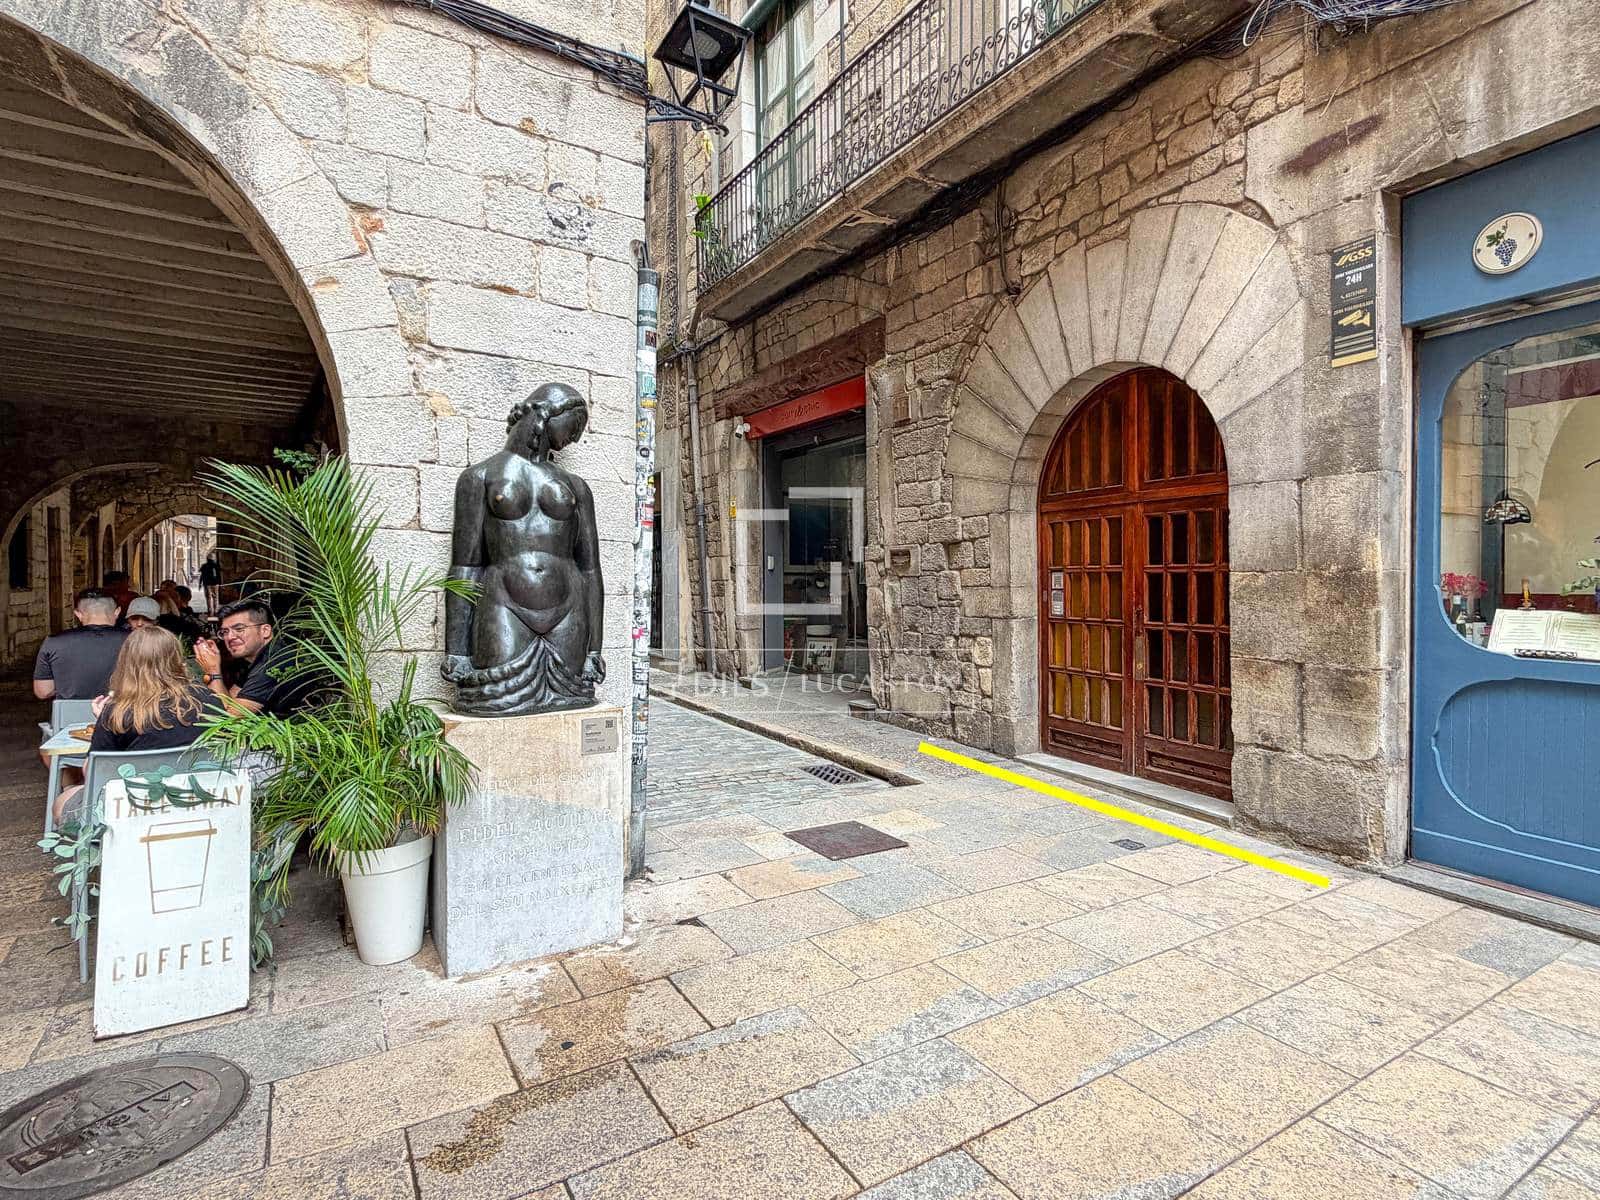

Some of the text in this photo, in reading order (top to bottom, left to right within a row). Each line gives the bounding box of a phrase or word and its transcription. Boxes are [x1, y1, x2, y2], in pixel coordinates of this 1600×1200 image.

[1350, 246, 1373, 262] GSS
[1345, 272, 1362, 286] 24H
[457, 822, 520, 844] FIDEL
[112, 936, 235, 982] COFFEE
